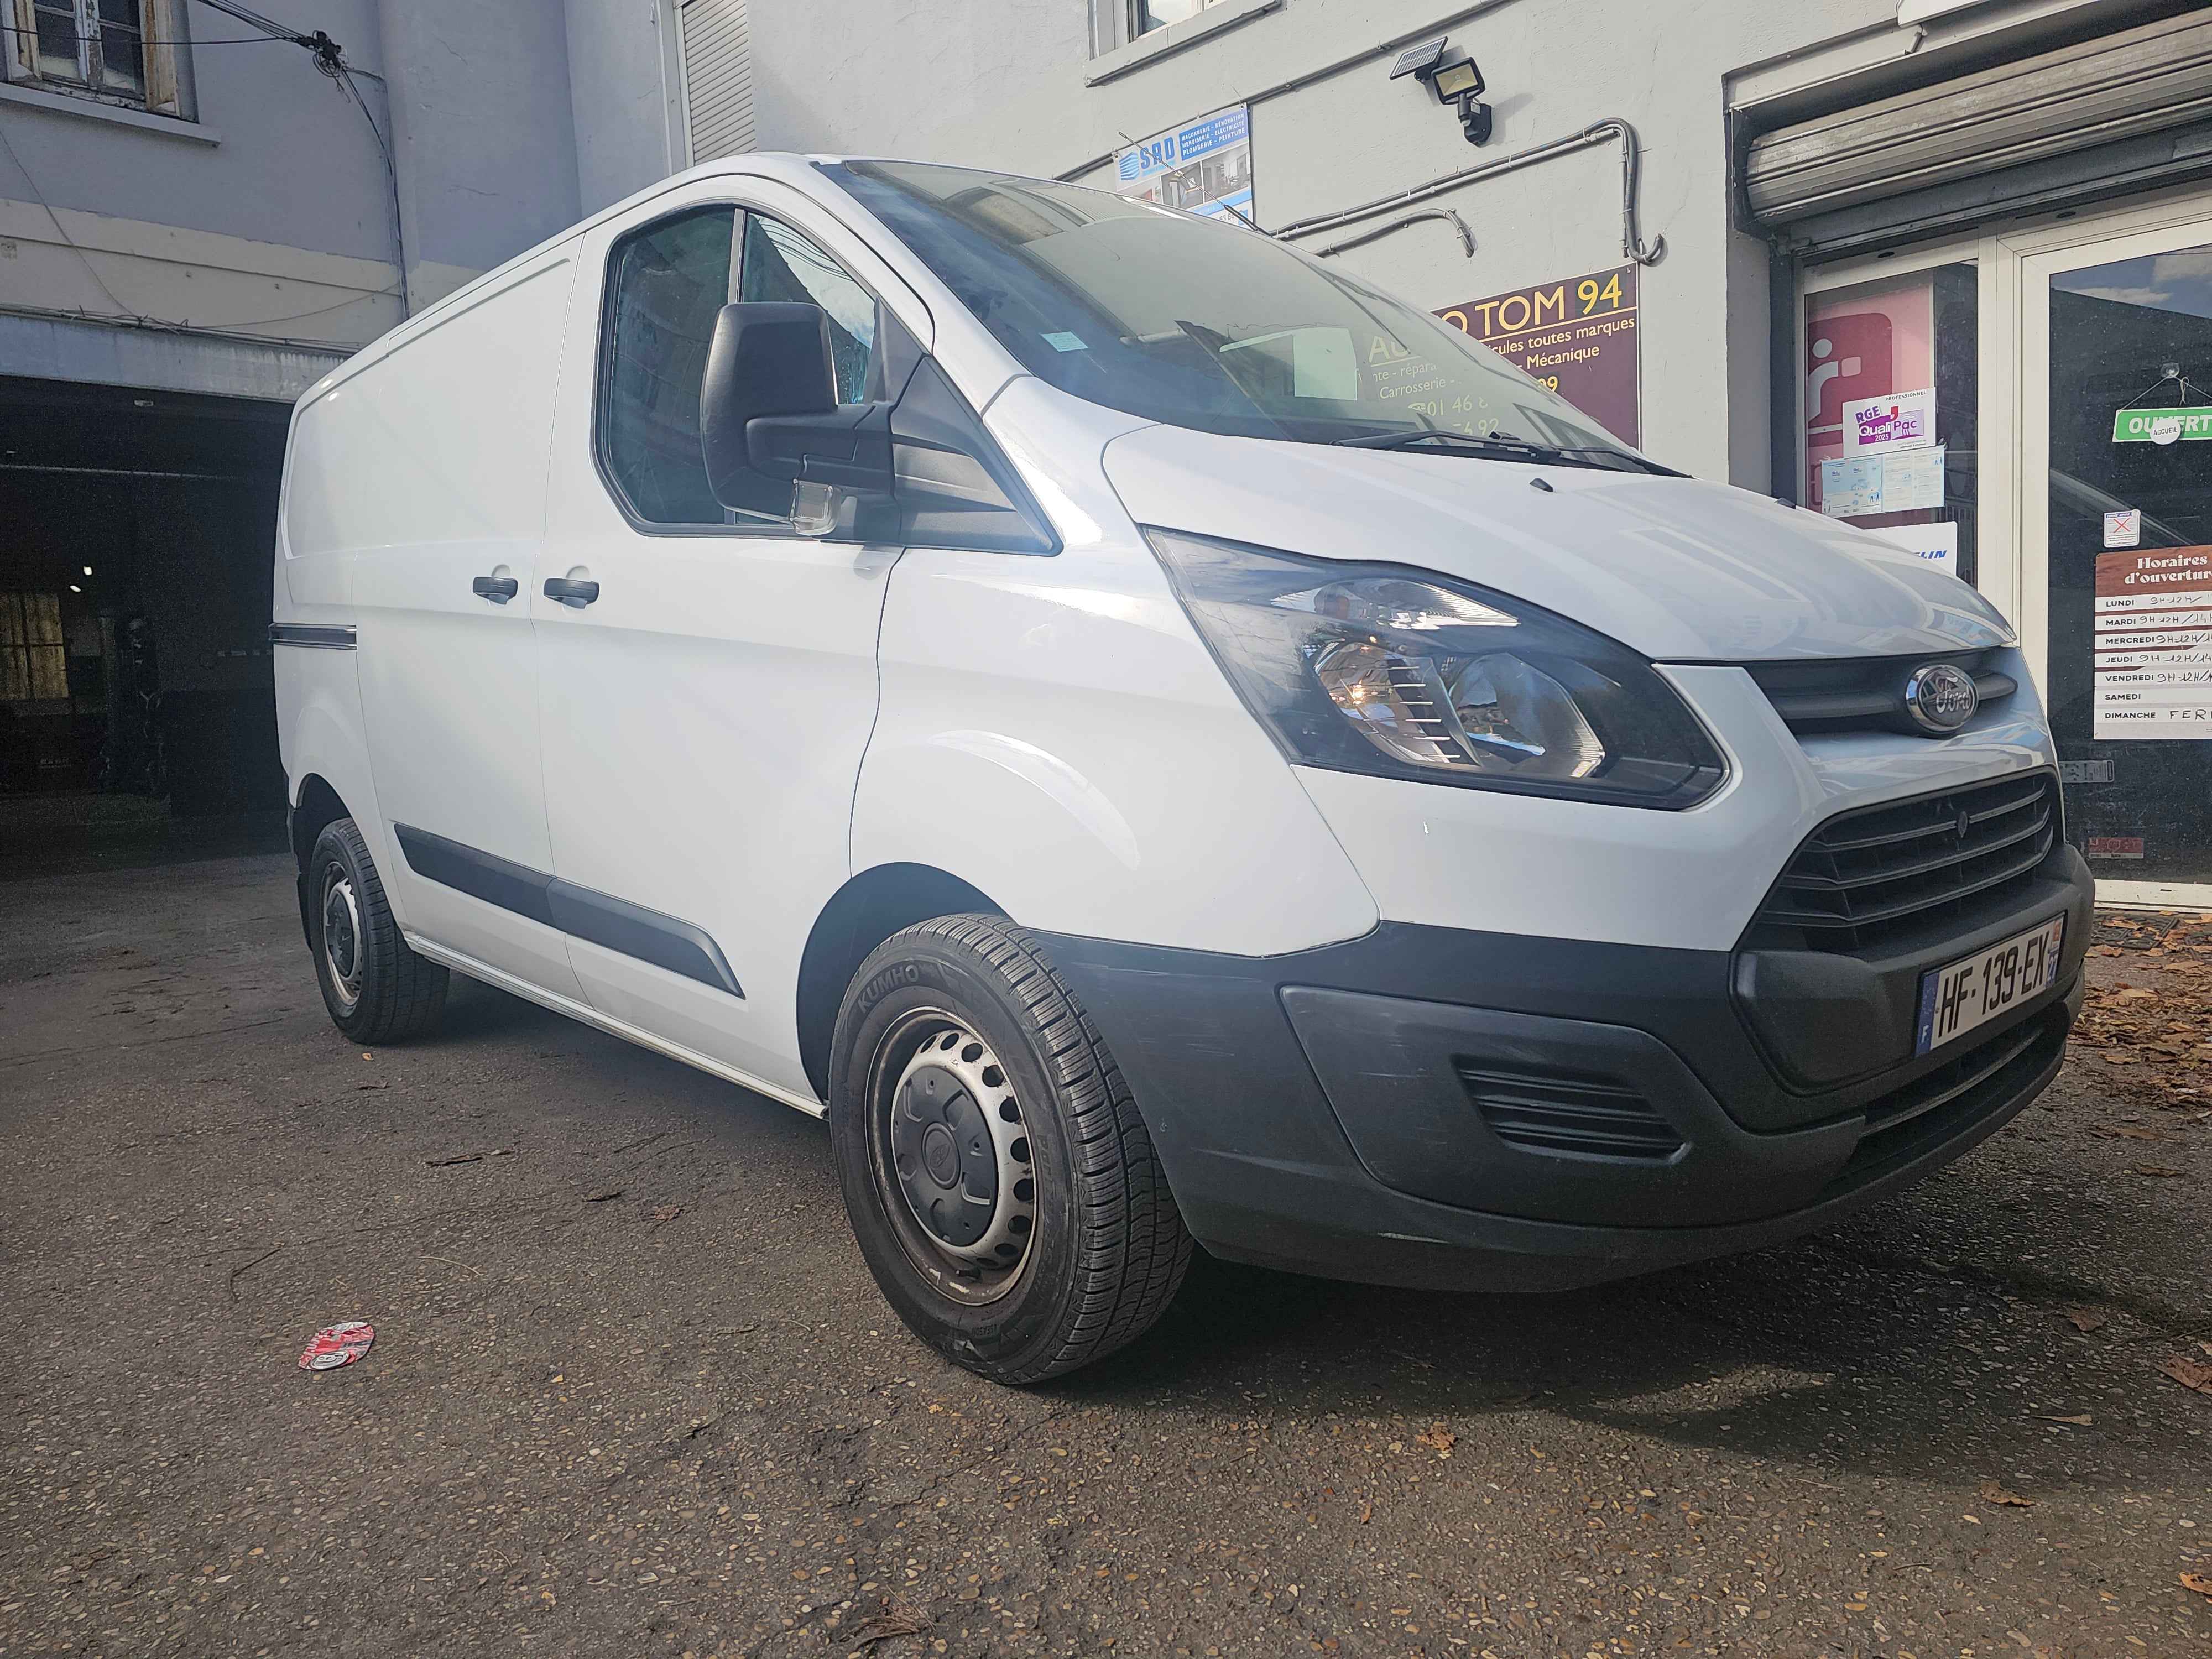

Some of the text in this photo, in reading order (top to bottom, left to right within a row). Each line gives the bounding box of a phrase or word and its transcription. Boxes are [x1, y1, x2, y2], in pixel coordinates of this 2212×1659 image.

[1181, 126, 1210, 141] MAÇONNERIE
[1215, 113, 1244, 128] RÉNOVATION
[1182, 133, 1210, 148] MENUISERIE
[1183, 139, 1212, 156] PLOMBERIE
[1218, 128, 1245, 142] PEINTURE
[1140, 137, 1175, 169] SRD
[1474, 286, 1564, 336] TOM
[1577, 273, 1623, 315] 94
[1527, 330, 1571, 349] toutes
[1576, 317, 1635, 339] marques
[1380, 377, 1447, 399] Carrosserie
[1526, 345, 1600, 369] Mécanique
[1427, 399, 1444, 416] 01
[1452, 394, 1473, 413] 46
[1885, 390, 1927, 401] PROFESSIONNEL
[1855, 405, 1881, 424] RGE
[1875, 434, 1889, 442] 2025
[2153, 426, 2178, 436] ACCUEIL
[1914, 550, 1947, 559] LIN
[2137, 554, 2208, 569] Horaires
[2124, 569, 2212, 585] d'ouvertur
[1936, 676, 1971, 714] Ford
[2169, 709, 2212, 720] FER
[858, 964, 919, 1013] KUMHO
[1921, 1025, 1929, 1044] F
